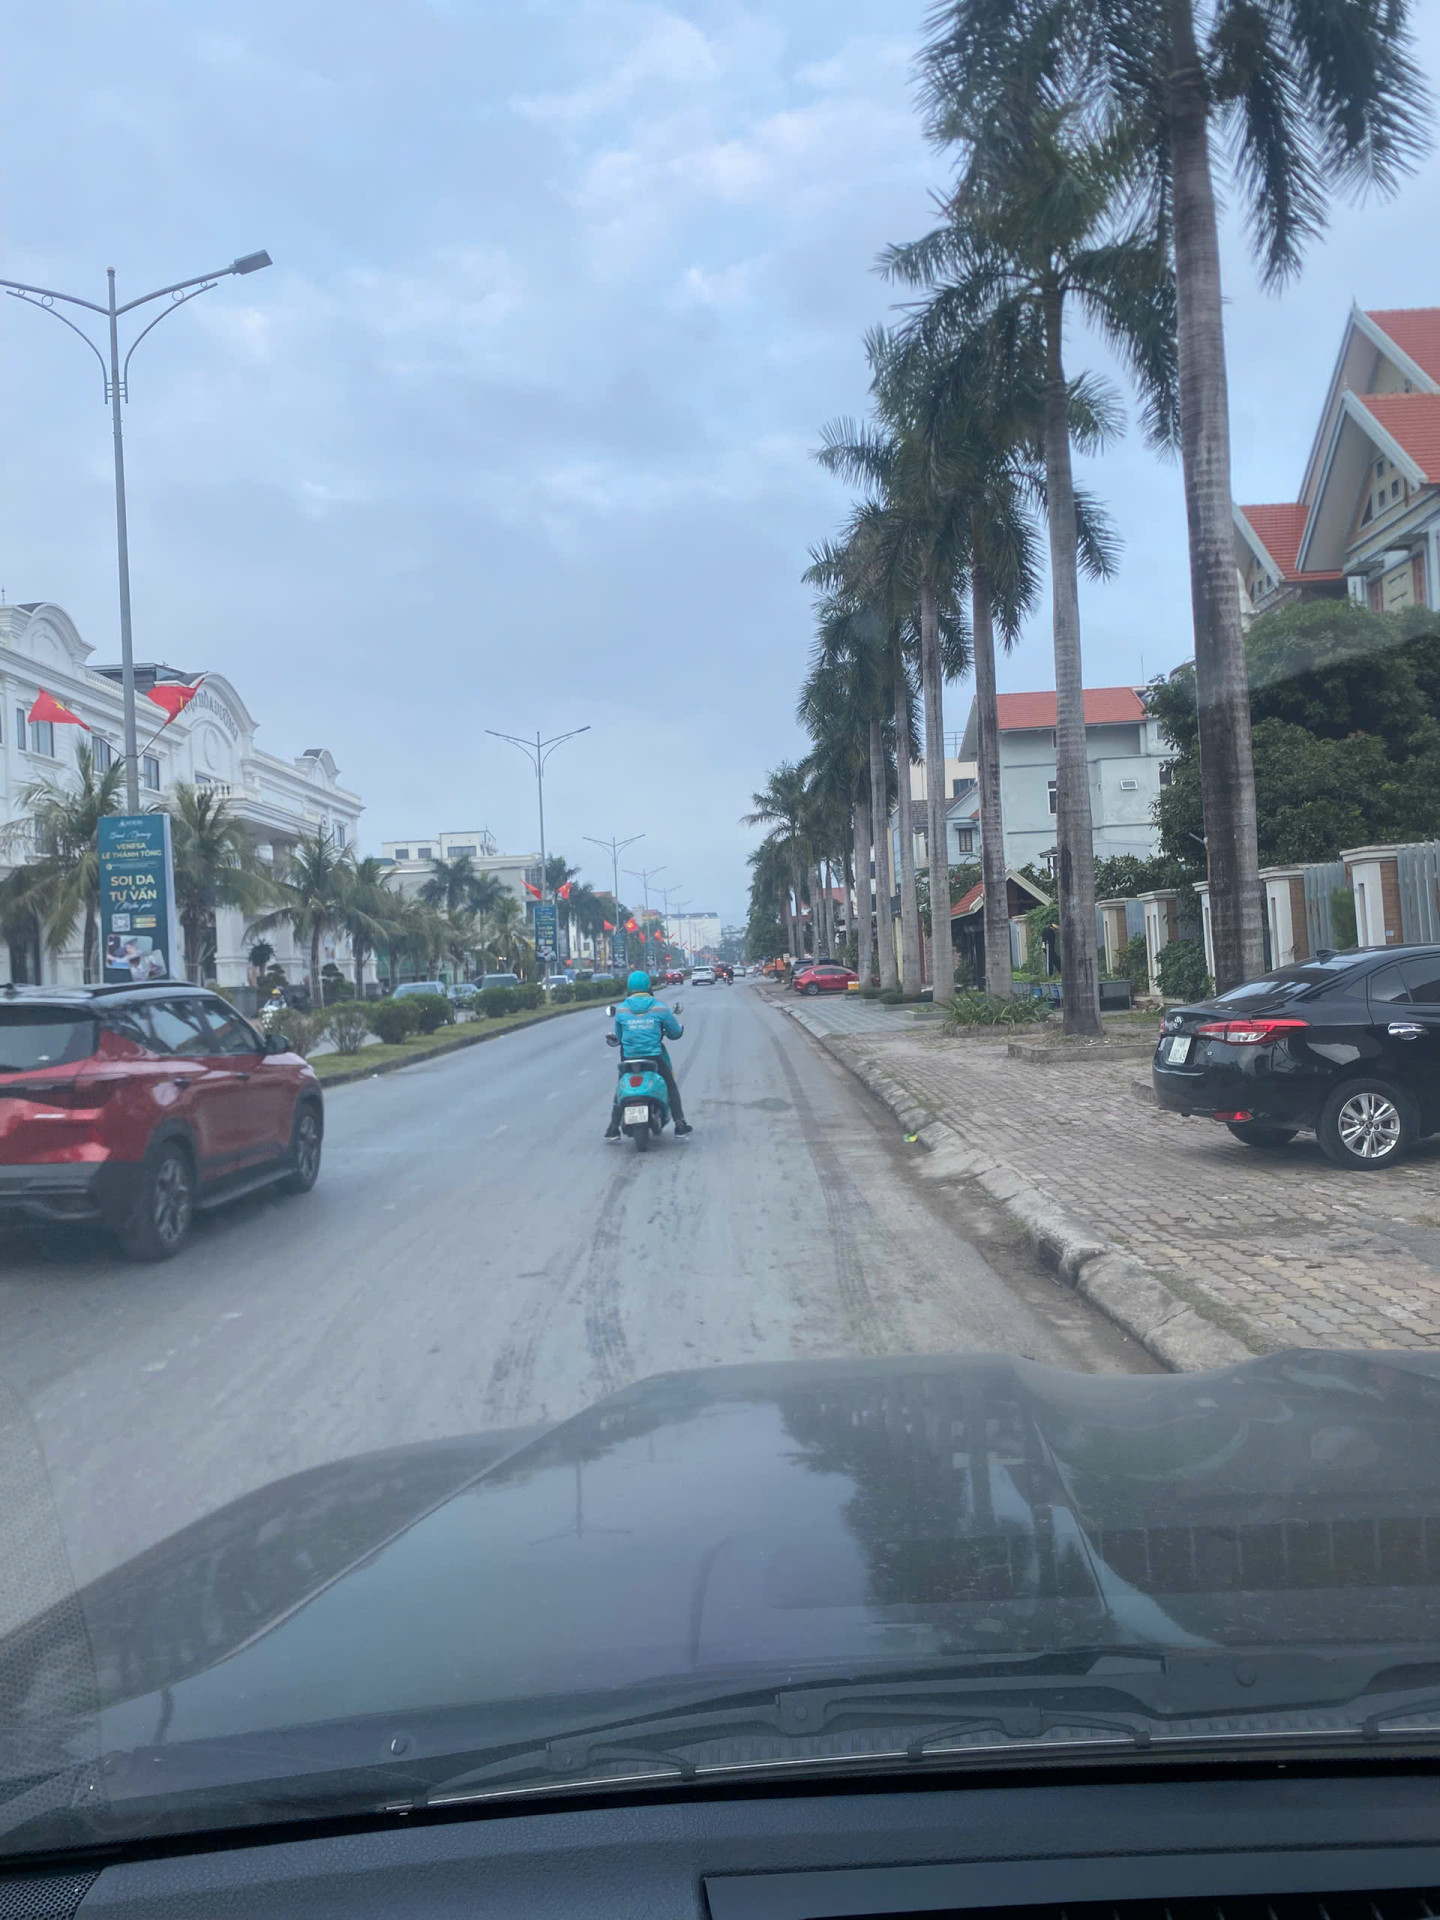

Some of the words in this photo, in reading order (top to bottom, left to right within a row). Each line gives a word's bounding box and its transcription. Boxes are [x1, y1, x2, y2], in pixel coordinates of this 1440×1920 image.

[141, 849, 162, 857] TÔNG
[111, 876, 132, 886] SOI
[136, 874, 155, 885] DA
[130, 887, 157, 900] VẤN
